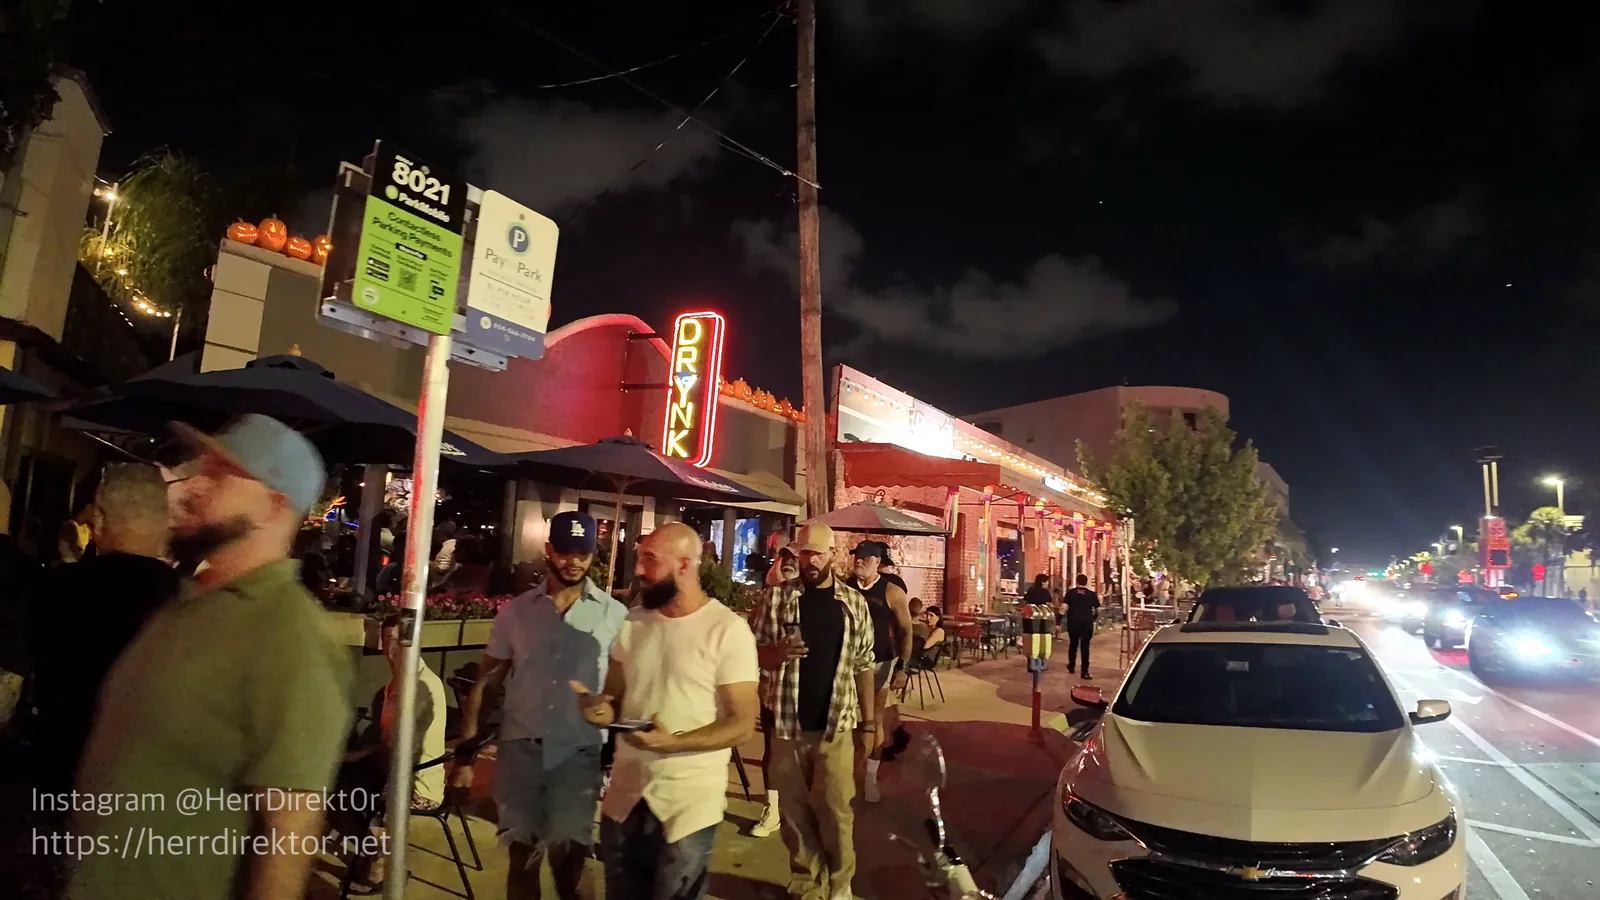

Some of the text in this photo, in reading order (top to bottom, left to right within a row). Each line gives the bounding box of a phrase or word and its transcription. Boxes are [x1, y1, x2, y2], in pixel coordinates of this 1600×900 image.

[392, 161, 450, 205] 8021
[372, 216, 408, 240] Parking
[409, 232, 453, 258] Payments
[388, 212, 441, 241] Contactless
[512, 230, 526, 248] P
[485, 247, 506, 269] Pay
[517, 262, 542, 282] Park
[667, 318, 702, 458] DRYNK
